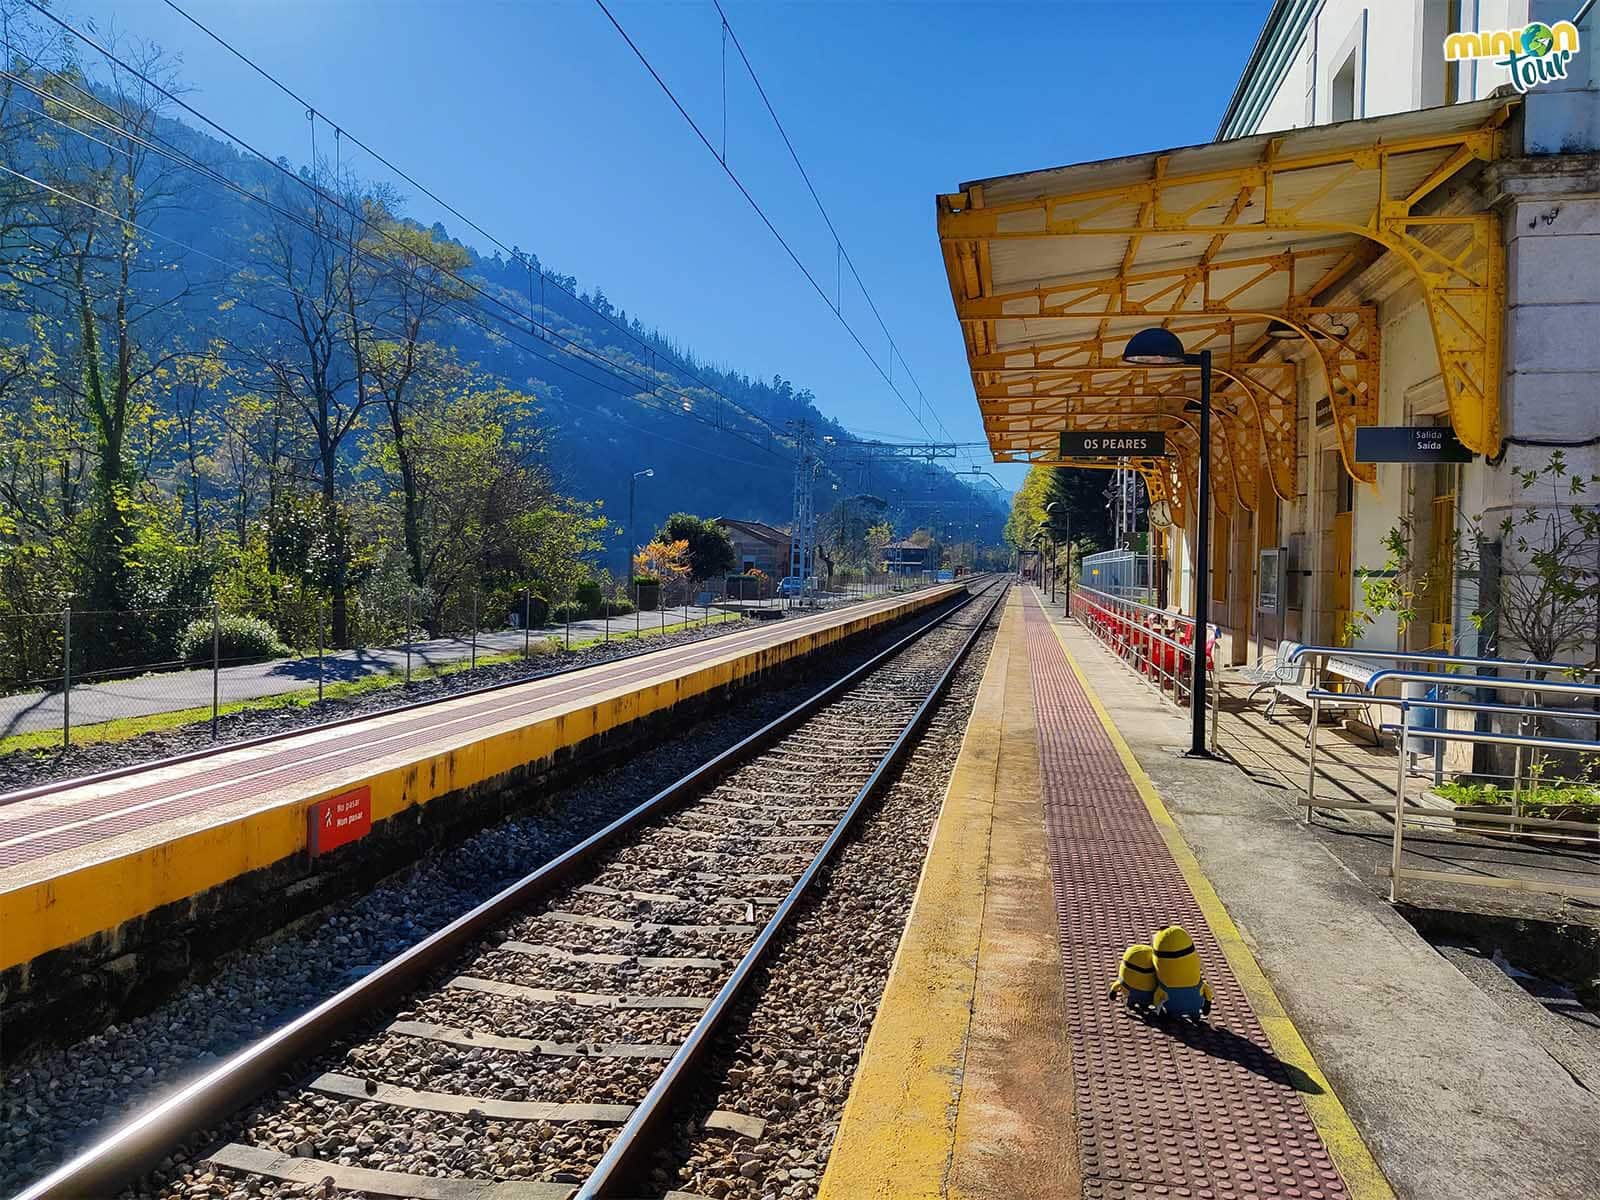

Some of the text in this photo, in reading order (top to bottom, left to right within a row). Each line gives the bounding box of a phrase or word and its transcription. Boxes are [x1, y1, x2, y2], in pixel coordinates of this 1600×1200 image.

[1416, 431, 1442, 439] Salida
[1084, 439, 1147, 449] OS PEARES
[1417, 441, 1441, 450] Saída
[1123, 541, 1130, 551] 2
[346, 799, 360, 811] pasar
[348, 811, 363, 824] pasar
